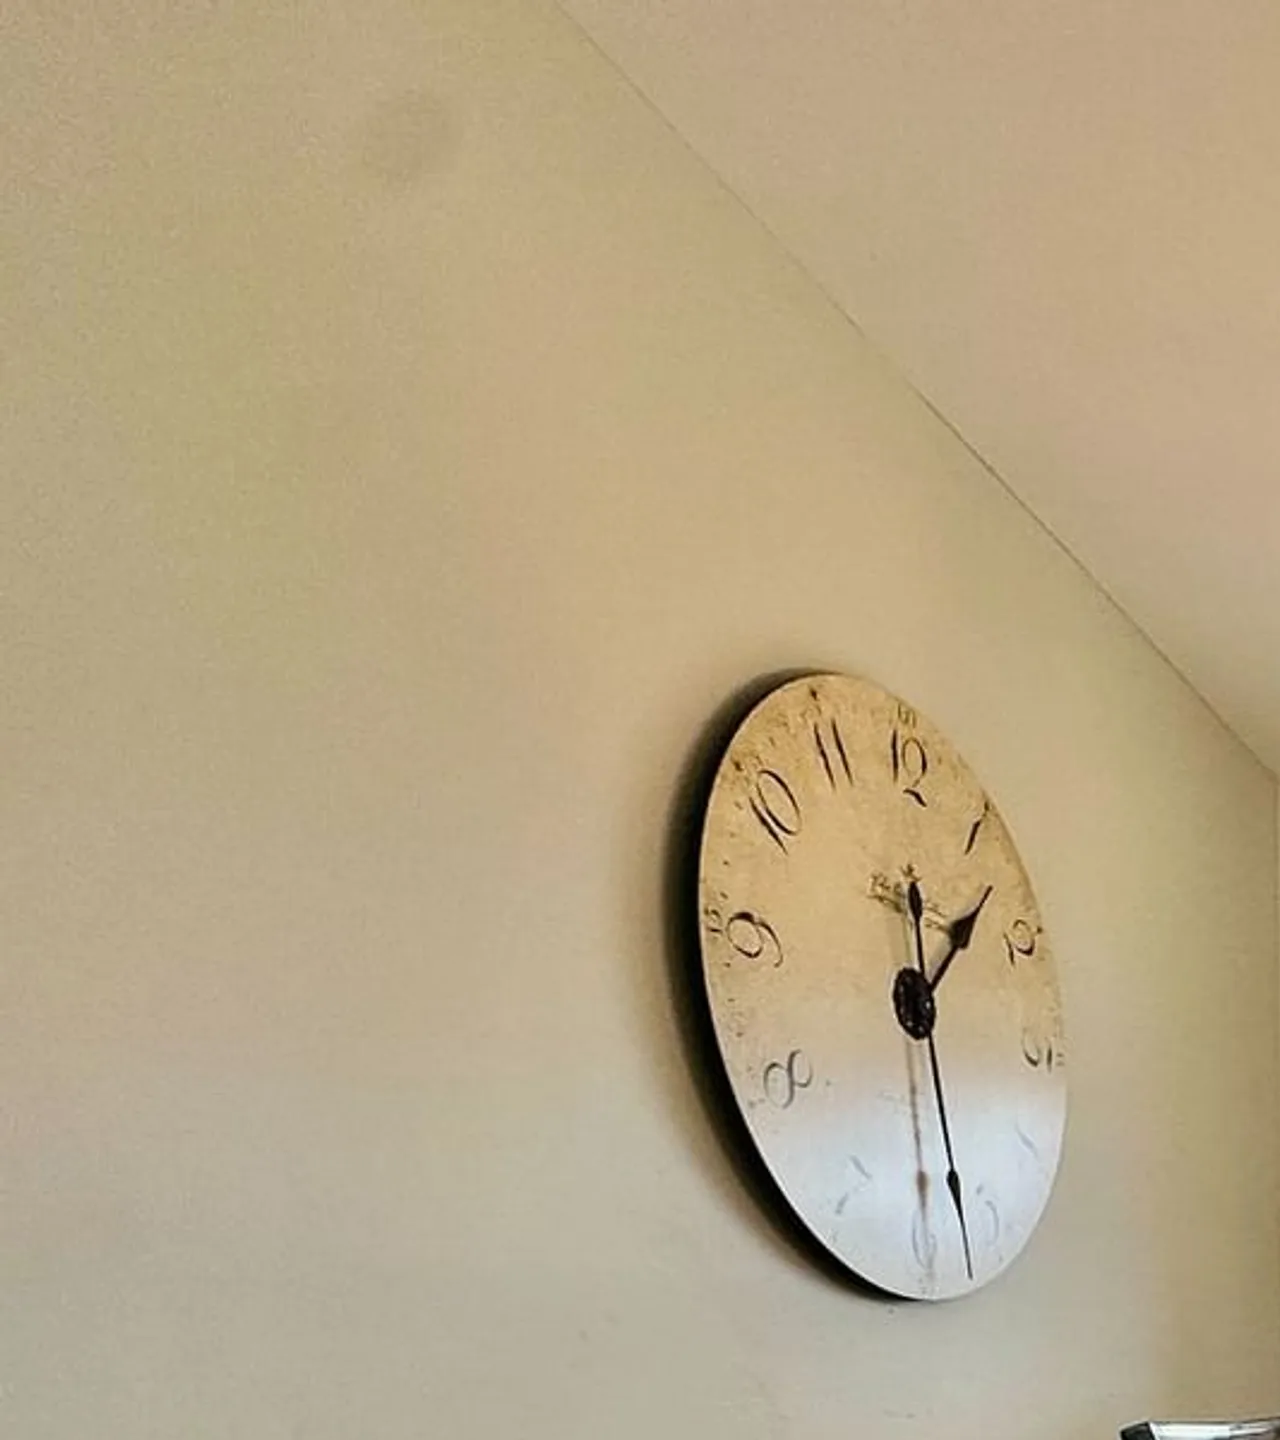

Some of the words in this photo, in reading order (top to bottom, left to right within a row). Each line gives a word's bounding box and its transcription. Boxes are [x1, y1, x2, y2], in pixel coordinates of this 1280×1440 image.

[814, 718, 854, 792] 11
[891, 729, 928, 807] 12
[748, 769, 803, 856] 10
[726, 911, 784, 969] 9
[763, 1049, 813, 1109] 8
